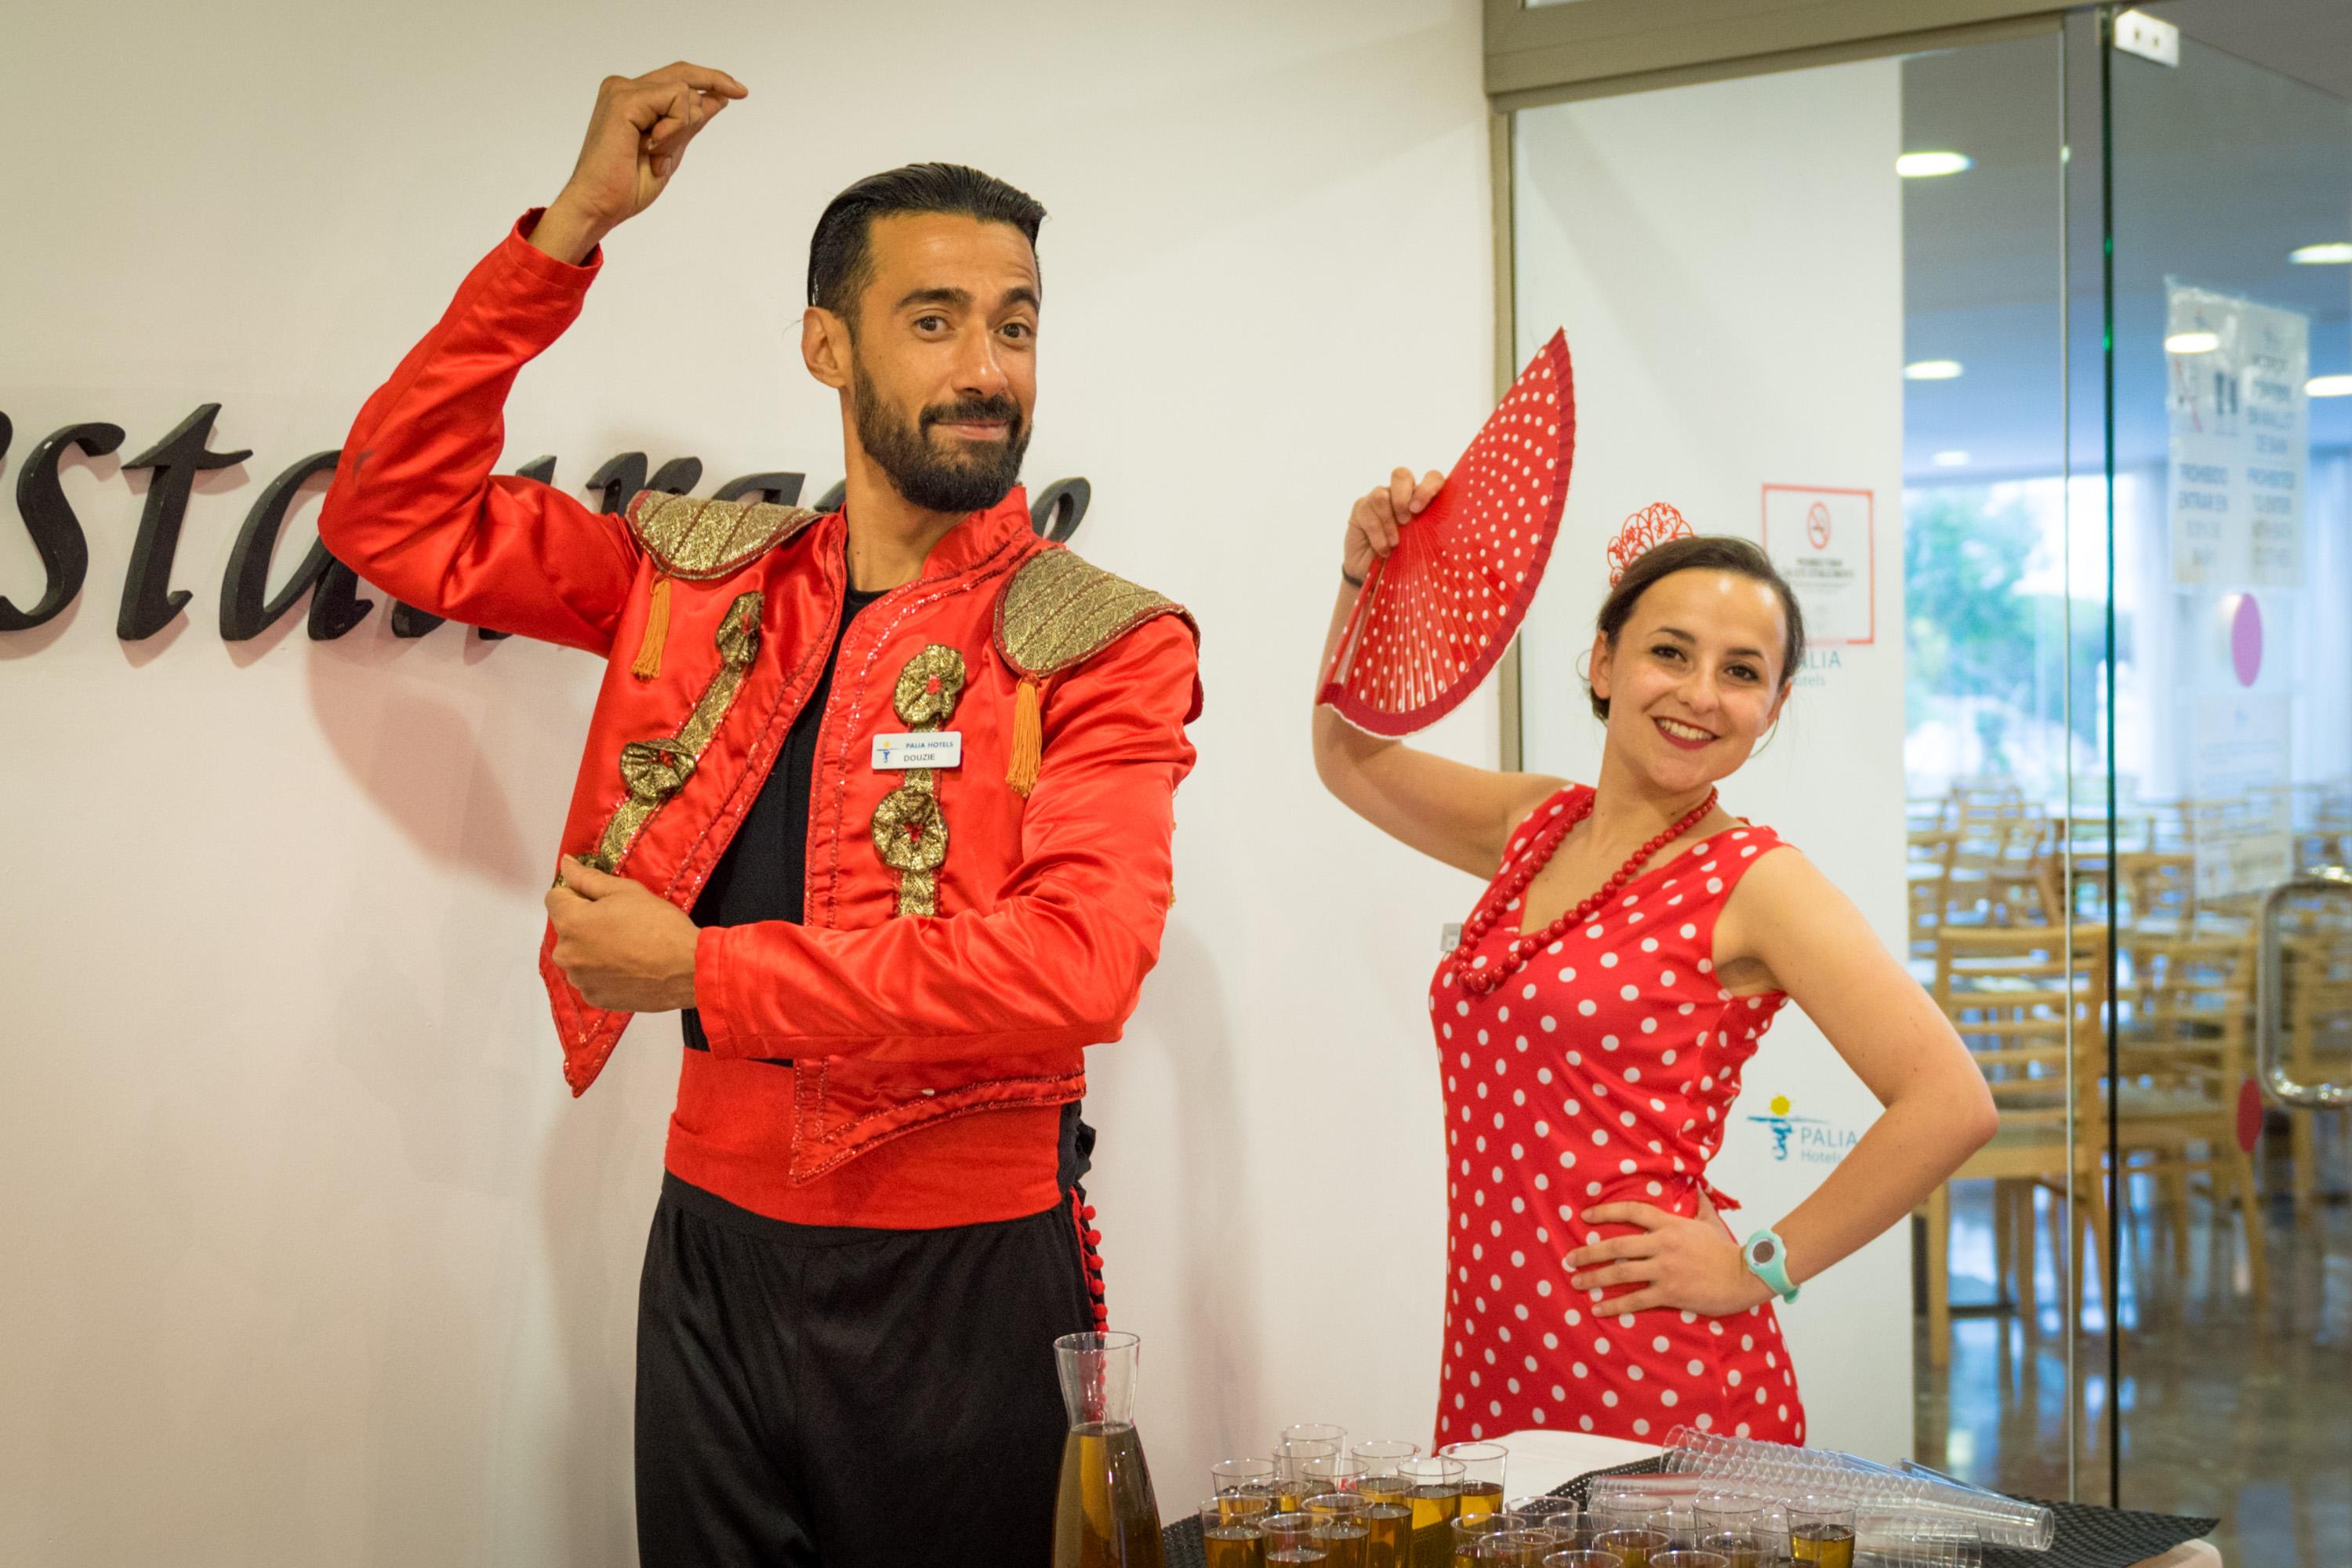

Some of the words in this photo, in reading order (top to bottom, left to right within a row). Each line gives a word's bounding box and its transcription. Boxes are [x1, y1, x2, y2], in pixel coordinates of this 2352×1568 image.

[1798, 650, 1842, 670] ALIA
[1793, 672, 1826, 687] otels
[1801, 1127, 1858, 1148] PALIA
